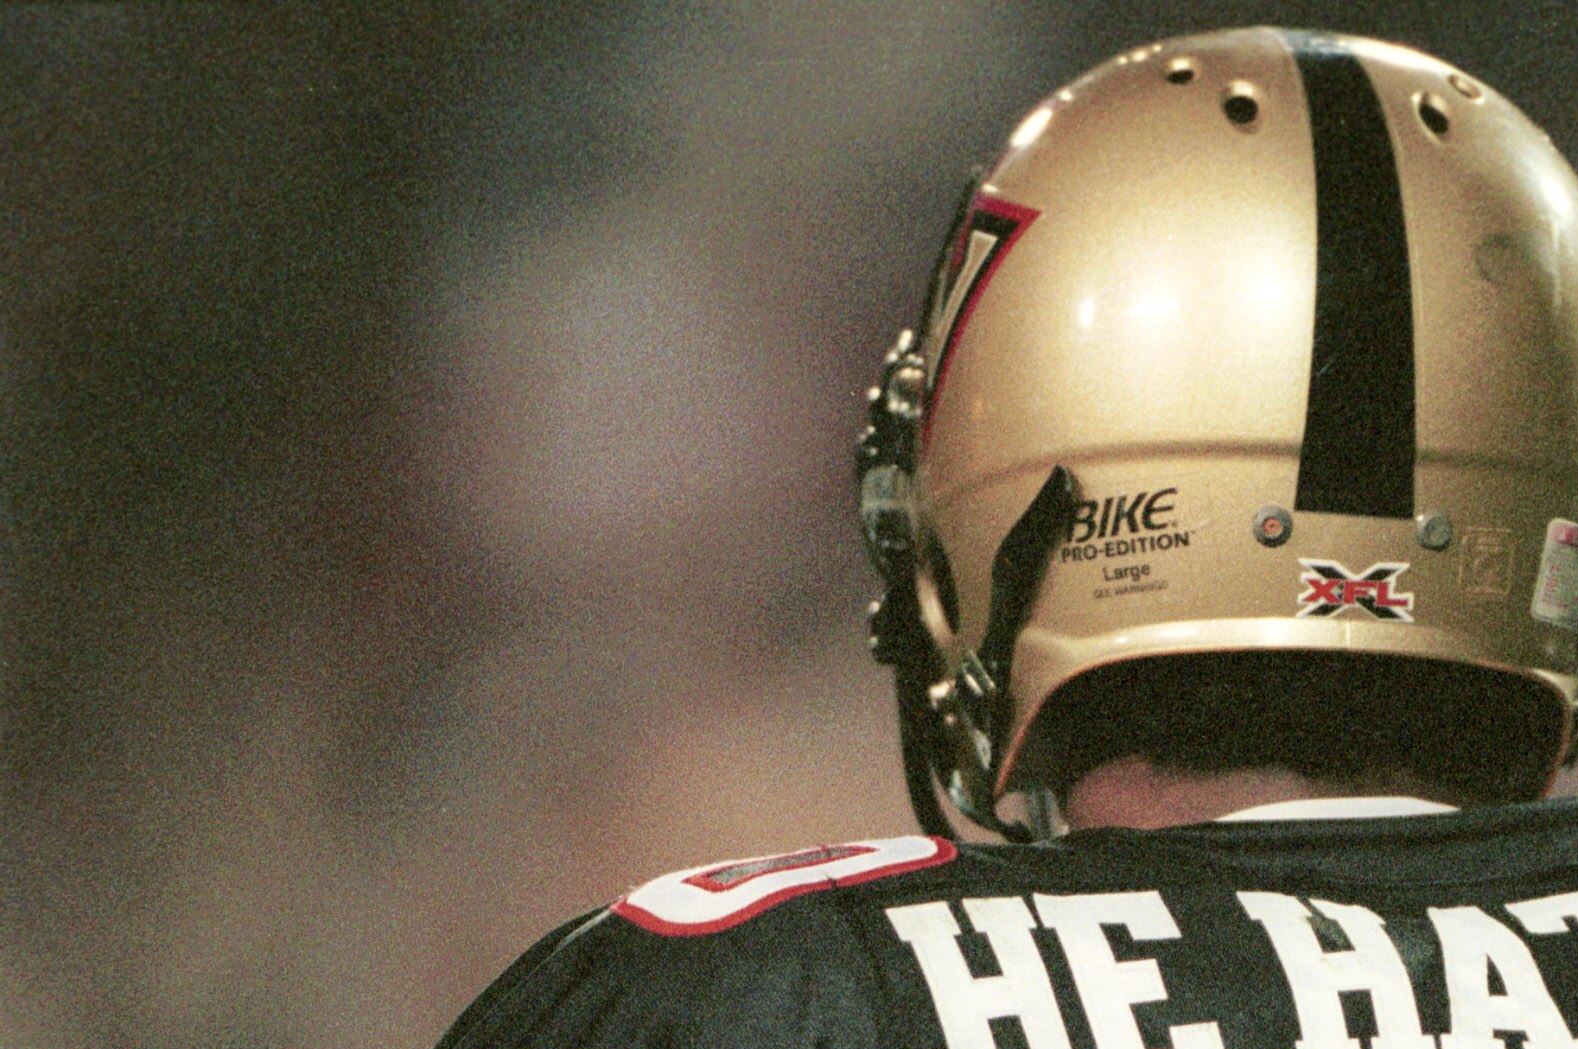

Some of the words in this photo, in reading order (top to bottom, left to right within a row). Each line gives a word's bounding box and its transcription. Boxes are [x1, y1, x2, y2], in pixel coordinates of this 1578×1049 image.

[1067, 487, 1178, 543] BIKE
[1061, 531, 1191, 563] PRO-EDITION
[1103, 564, 1151, 582] Large
[1298, 572, 1414, 614] XFL
